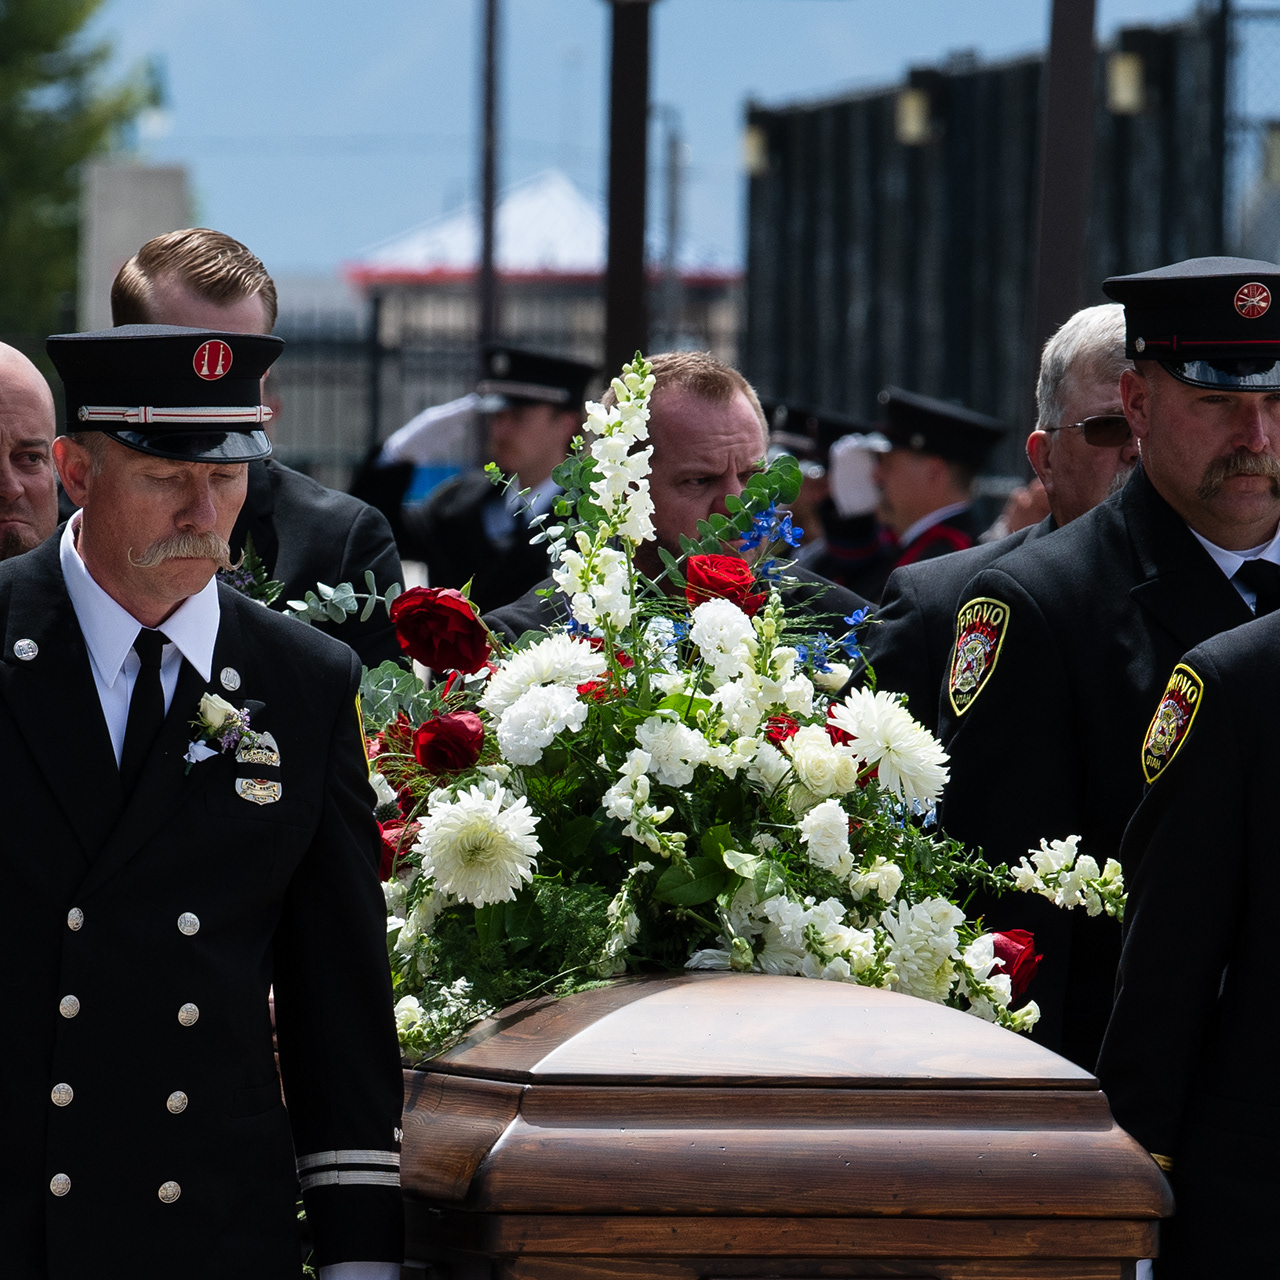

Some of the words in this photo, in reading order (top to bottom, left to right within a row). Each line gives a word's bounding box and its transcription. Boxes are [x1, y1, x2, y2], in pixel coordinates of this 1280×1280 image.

[960, 604, 1005, 633] PROVO
[955, 692, 972, 705] UTAH
[1145, 755, 1162, 770] UTAH
